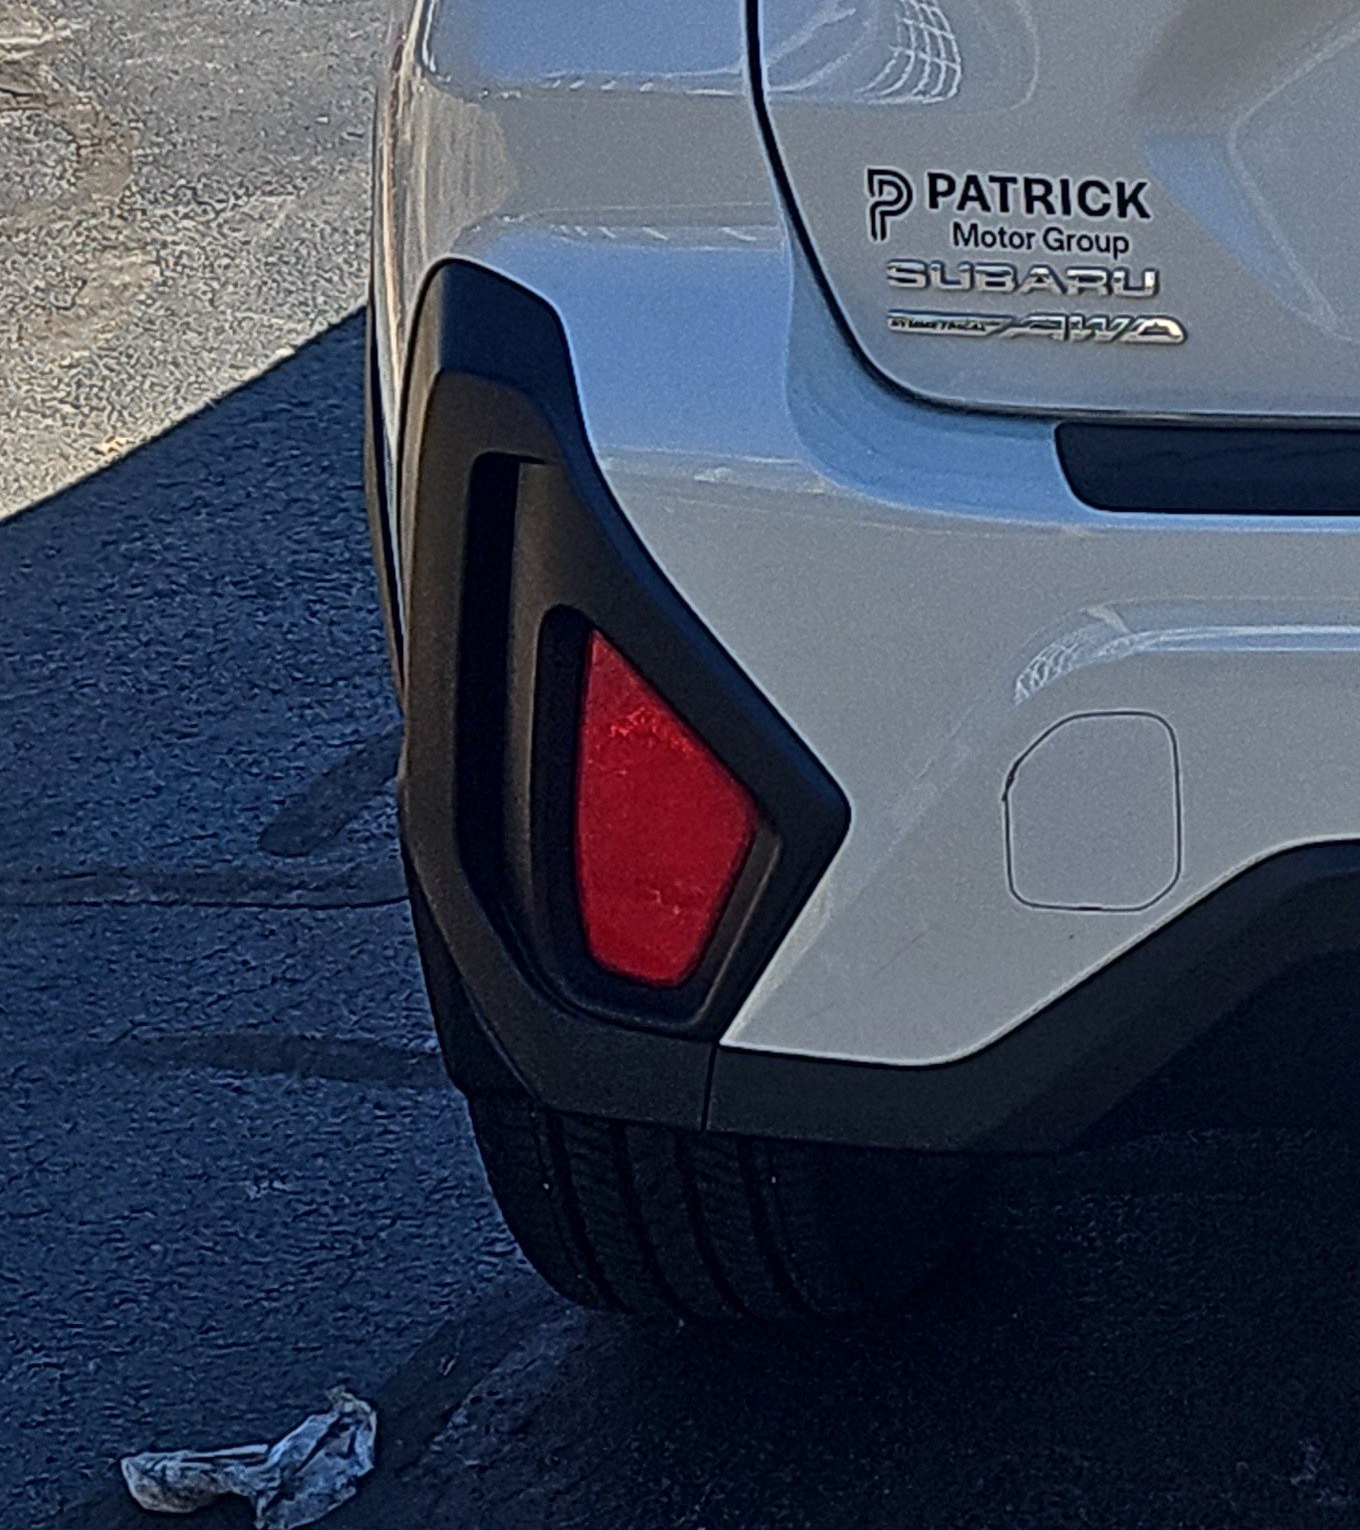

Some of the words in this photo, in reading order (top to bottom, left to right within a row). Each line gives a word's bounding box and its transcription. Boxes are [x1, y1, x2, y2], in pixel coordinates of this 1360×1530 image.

[927, 172, 1150, 219] PATRICK
[952, 222, 1036, 250] Motor
[1043, 228, 1130, 259] Group
[886, 260, 1160, 297] SUBARU
[1000, 312, 1188, 344] AWD
